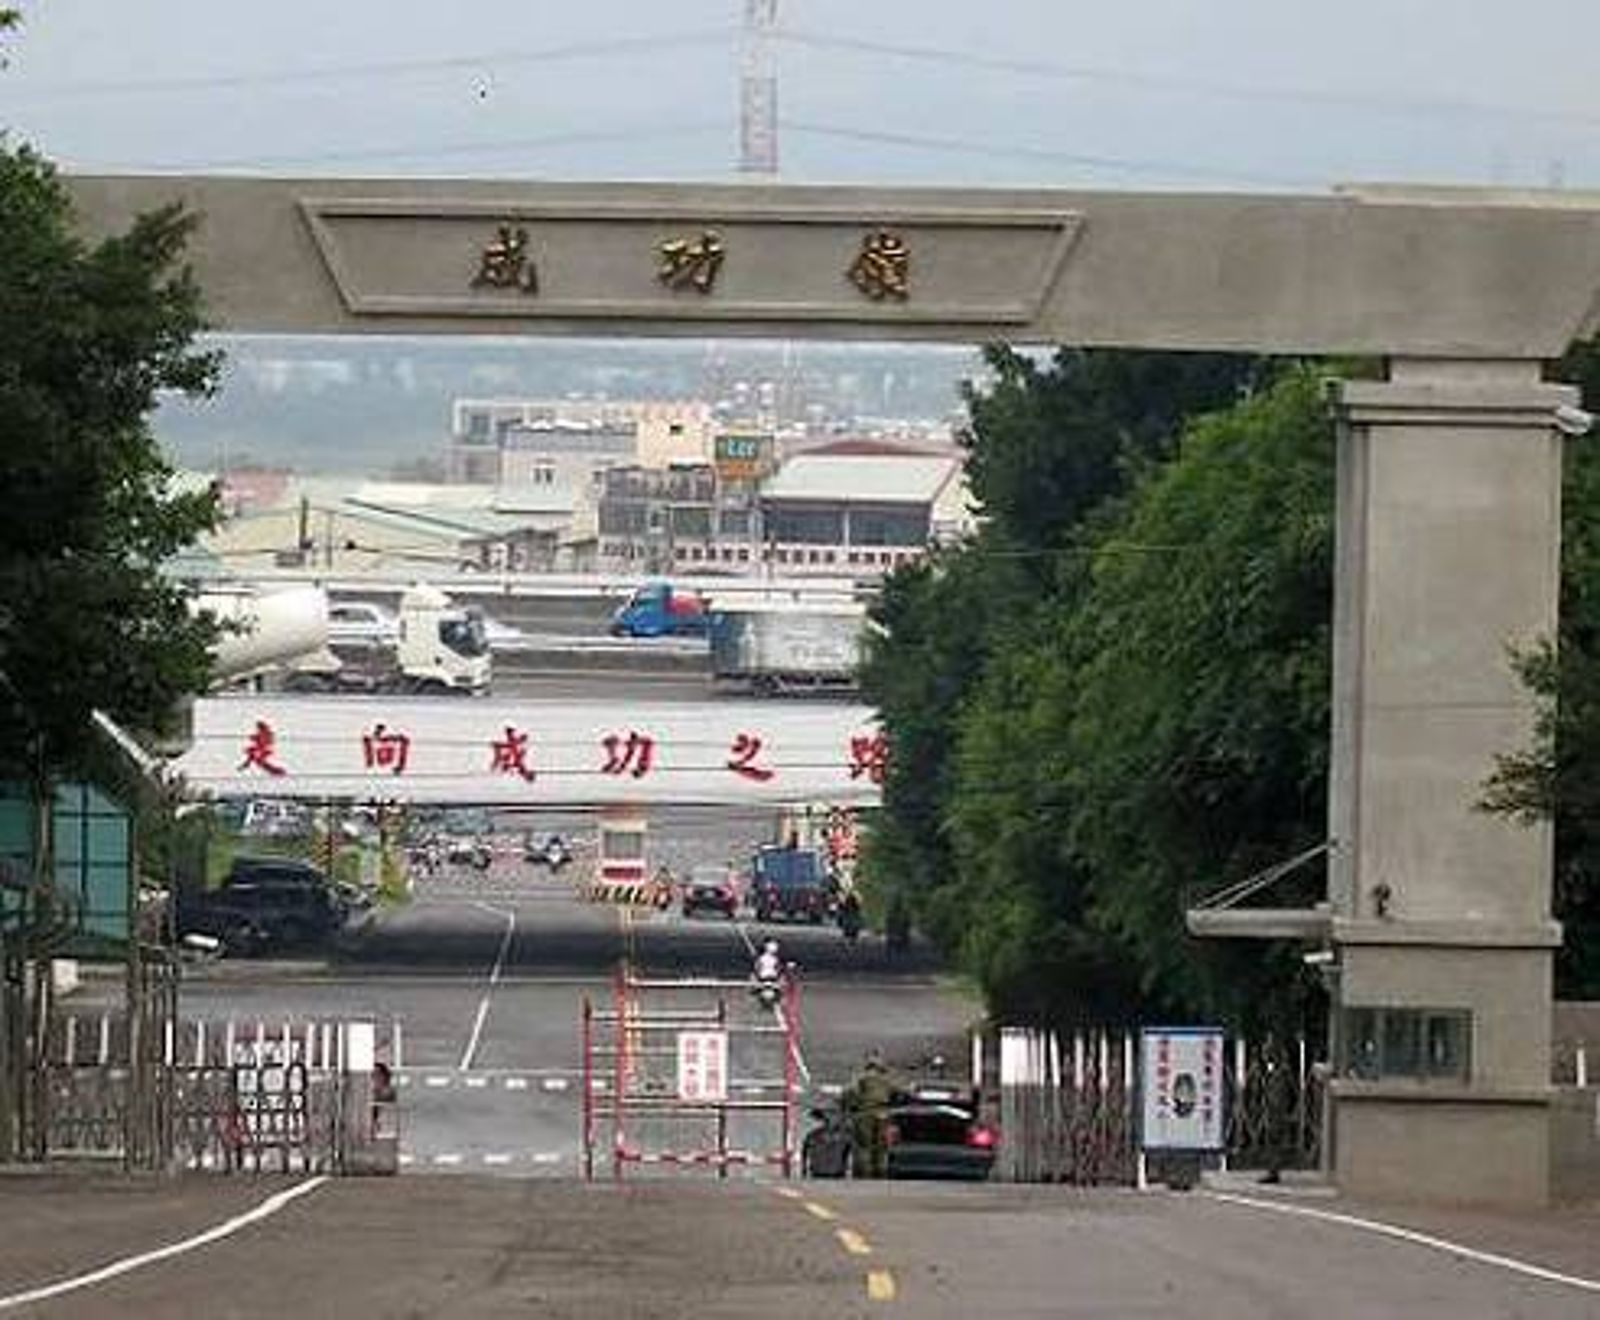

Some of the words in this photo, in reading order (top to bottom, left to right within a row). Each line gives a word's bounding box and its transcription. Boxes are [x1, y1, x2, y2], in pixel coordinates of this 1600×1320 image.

[237, 721, 889, 784] 走向成功之路
